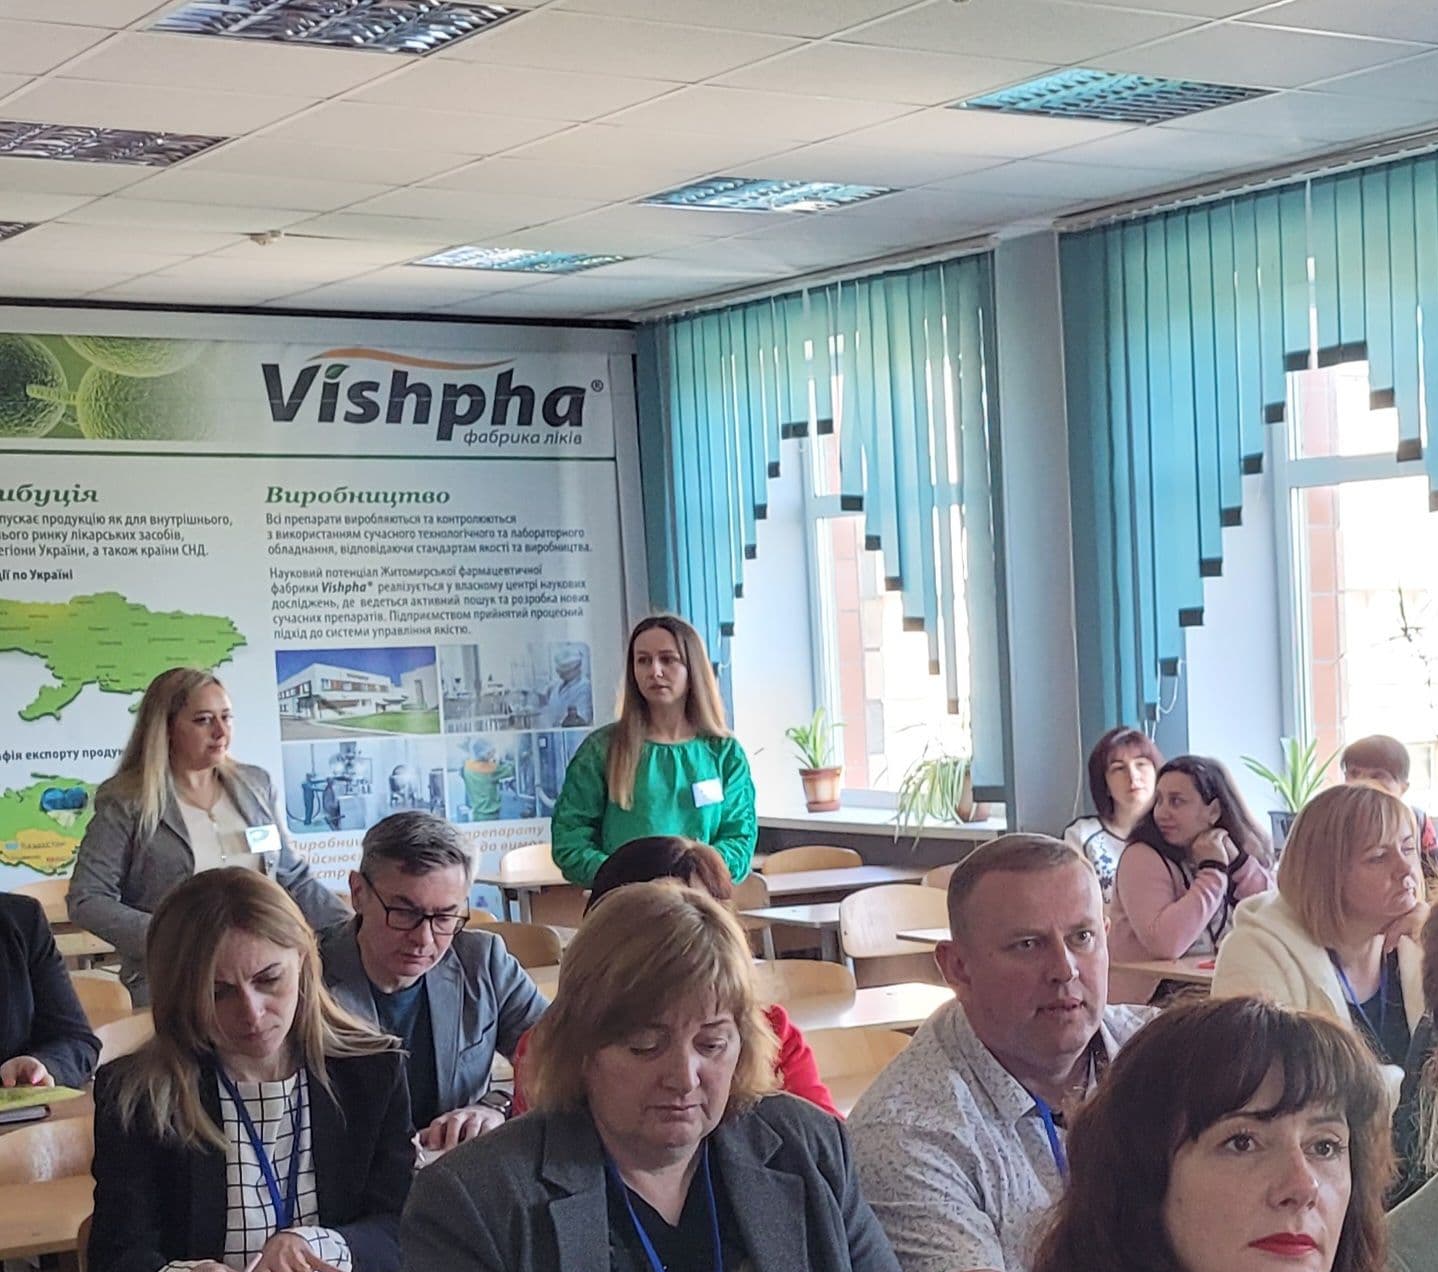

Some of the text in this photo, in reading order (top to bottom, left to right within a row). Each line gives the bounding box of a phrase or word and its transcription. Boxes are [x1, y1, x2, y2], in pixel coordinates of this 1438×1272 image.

[463, 429, 582, 447] фабрика ліків
[265, 486, 450, 508] Виробництво
[42, 512, 106, 528] продукцію
[108, 515, 123, 525] як
[124, 515, 147, 527] для
[149, 513, 233, 528] внутрішнього,
[266, 512, 517, 527] Всі препарати виробляються та контролюються
[0, 528, 185, 543] ього ринку лікарських засобів,
[275, 530, 362, 542] використанням
[364, 530, 416, 542] сучасного
[417, 528, 495, 540] технологічного
[497, 529, 508, 539] та
[510, 527, 585, 541] лабораторного
[38, 544, 90, 560] України,
[92, 546, 99, 556] а
[102, 546, 138, 556] також
[141, 546, 179, 558] країни
[182, 543, 209, 557] СНД.
[268, 542, 338, 557] обладнання,
[340, 542, 414, 555] відповідаючи
[416, 544, 477, 556] стандартам
[480, 541, 510, 553] якості
[511, 543, 522, 553] та
[13, 571, 28, 580] по
[30, 569, 73, 583] Україні
[269, 567, 323, 582] Науковий
[325, 566, 379, 579] потенціал
[380, 566, 456, 580] Житомирської
[271, 582, 319, 597] фабрики
[378, 582, 444, 595] реалізується
[446, 582, 453, 594] у
[505, 579, 538, 592] центрі
[272, 598, 339, 610] досліджень,
[342, 598, 355, 609] де
[360, 597, 408, 608] ведеться
[410, 595, 460, 607] активний
[463, 595, 497, 608] пошук
[499, 595, 509, 605] та
[273, 614, 322, 627] сучасних
[274, 627, 308, 641] підхід
[310, 628, 323, 640] до
[325, 626, 370, 639] системи
[0, 750, 22, 764] фія
[25, 749, 79, 762] експорту
